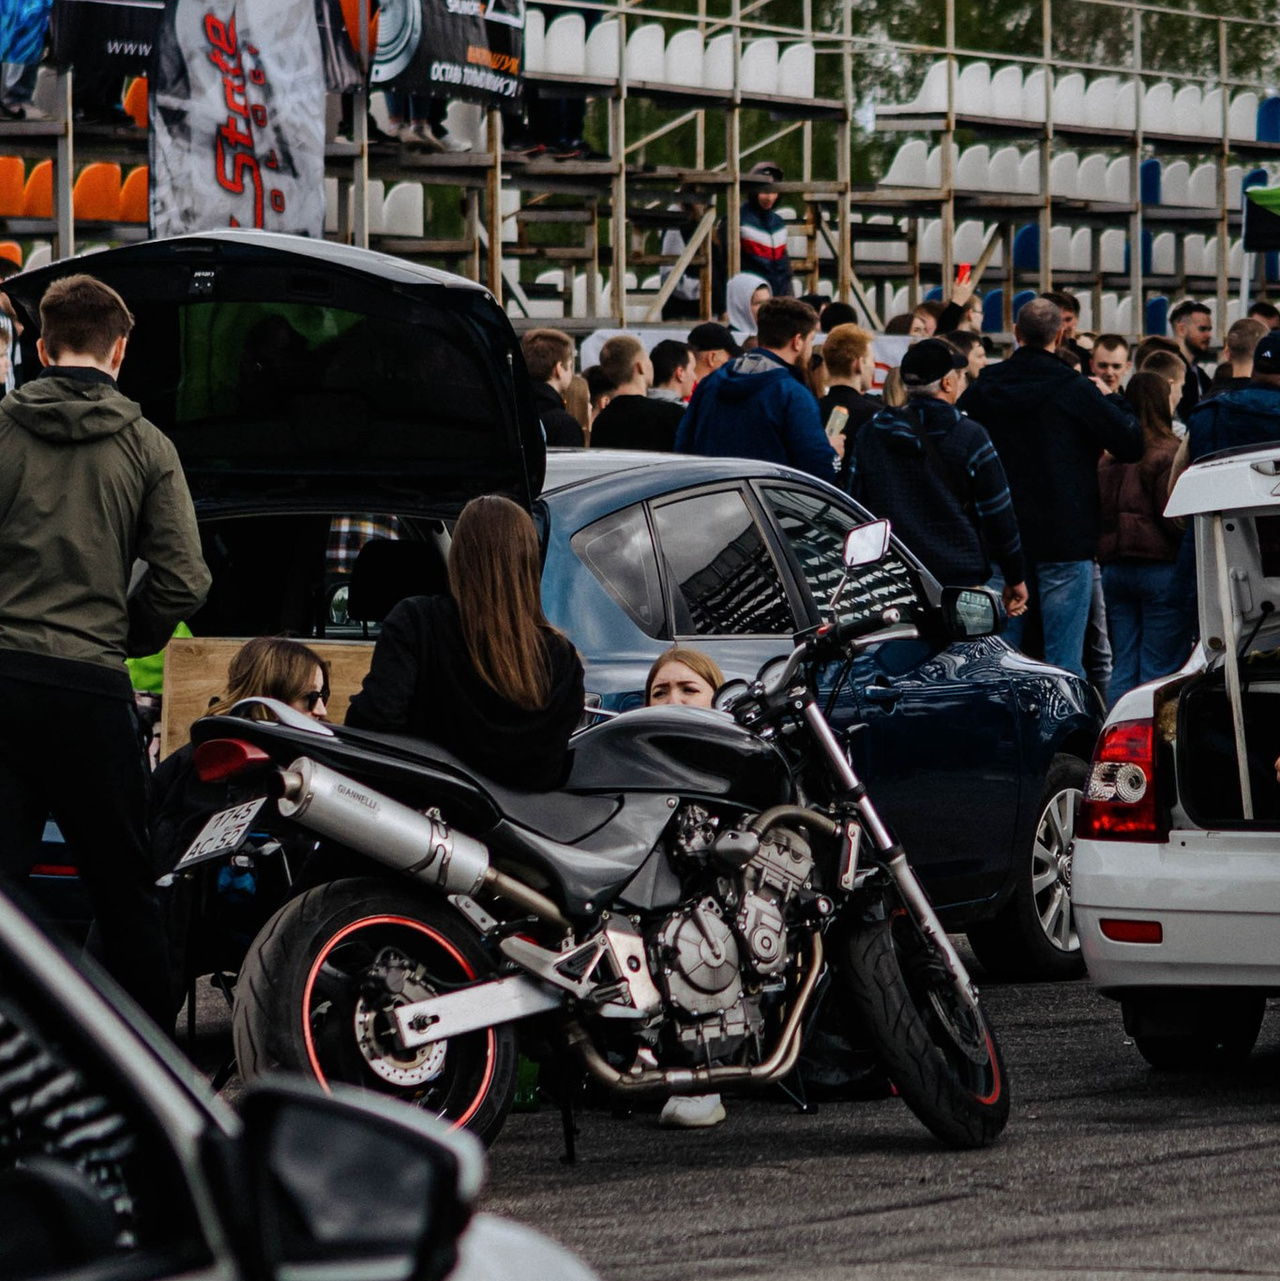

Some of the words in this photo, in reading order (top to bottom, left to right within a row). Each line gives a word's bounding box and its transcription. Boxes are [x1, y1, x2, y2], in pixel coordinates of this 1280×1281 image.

[336, 783, 379, 811] GIANNELLI
[213, 801, 257, 829] 1745
[215, 828, 241, 849] 52
